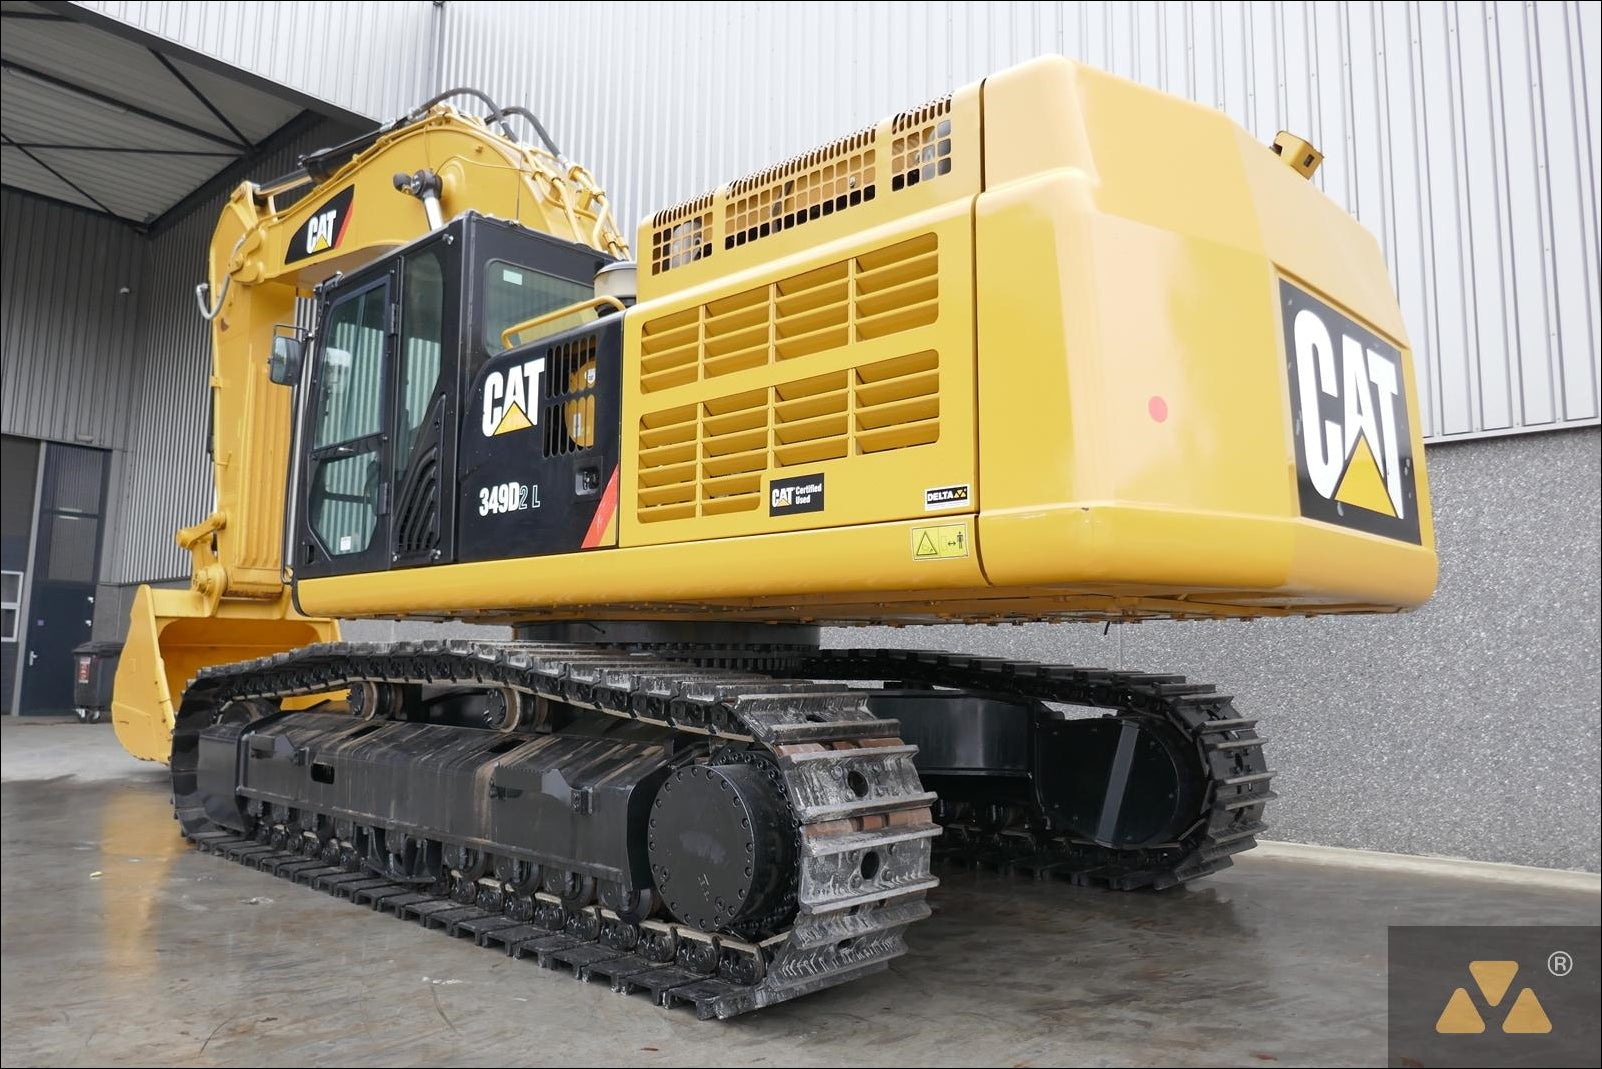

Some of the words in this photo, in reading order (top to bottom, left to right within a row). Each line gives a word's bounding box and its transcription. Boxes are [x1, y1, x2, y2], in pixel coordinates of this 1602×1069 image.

[306, 209, 337, 254] CAT
[482, 357, 546, 437] CAT
[1293, 309, 1404, 520] CAT
[531, 484, 541, 509] L
[771, 486, 794, 508] CAT
[795, 483, 822, 495] Certified
[795, 494, 811, 505] Used
[927, 490, 954, 502] DELTA
